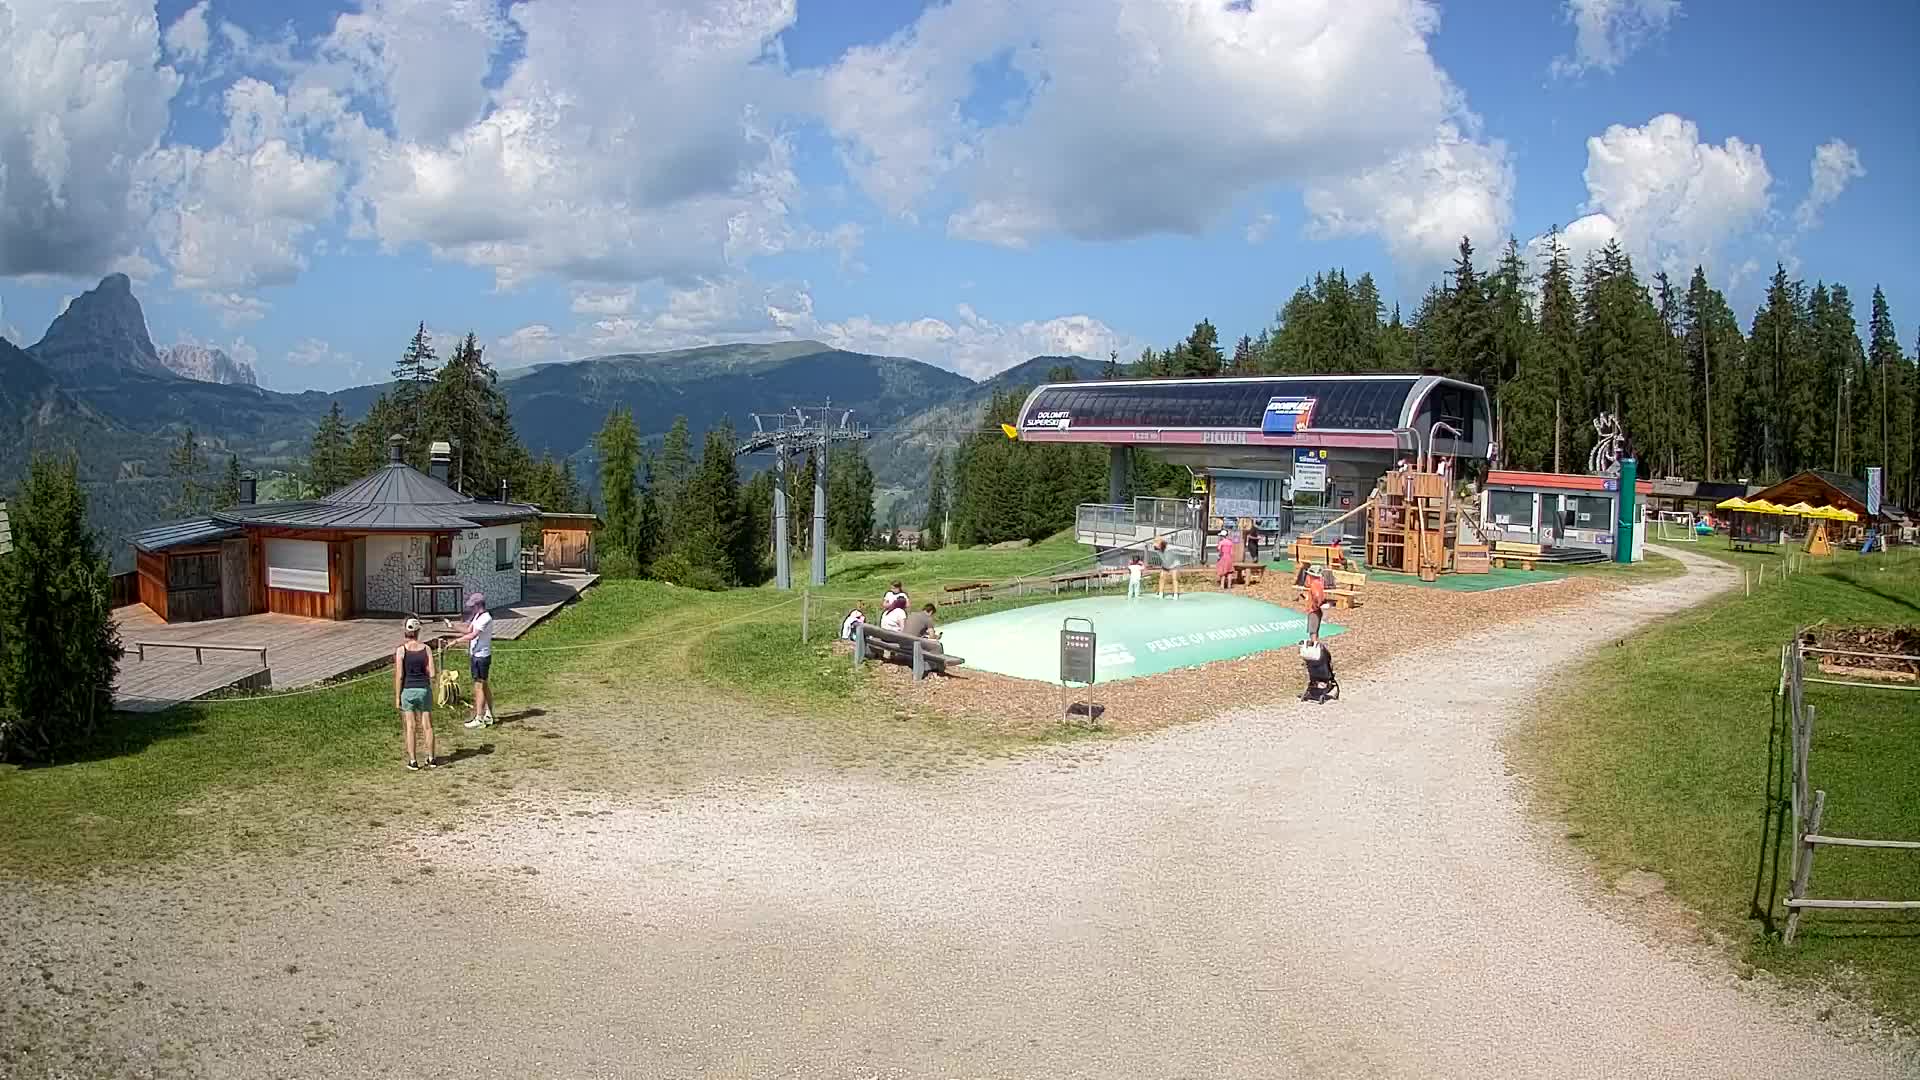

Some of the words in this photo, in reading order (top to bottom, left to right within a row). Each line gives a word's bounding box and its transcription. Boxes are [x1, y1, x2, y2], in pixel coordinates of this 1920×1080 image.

[1202, 431, 1248, 444] PICULIN
[1145, 636, 1190, 653] PEACE
[1249, 623, 1271, 633] ALL
